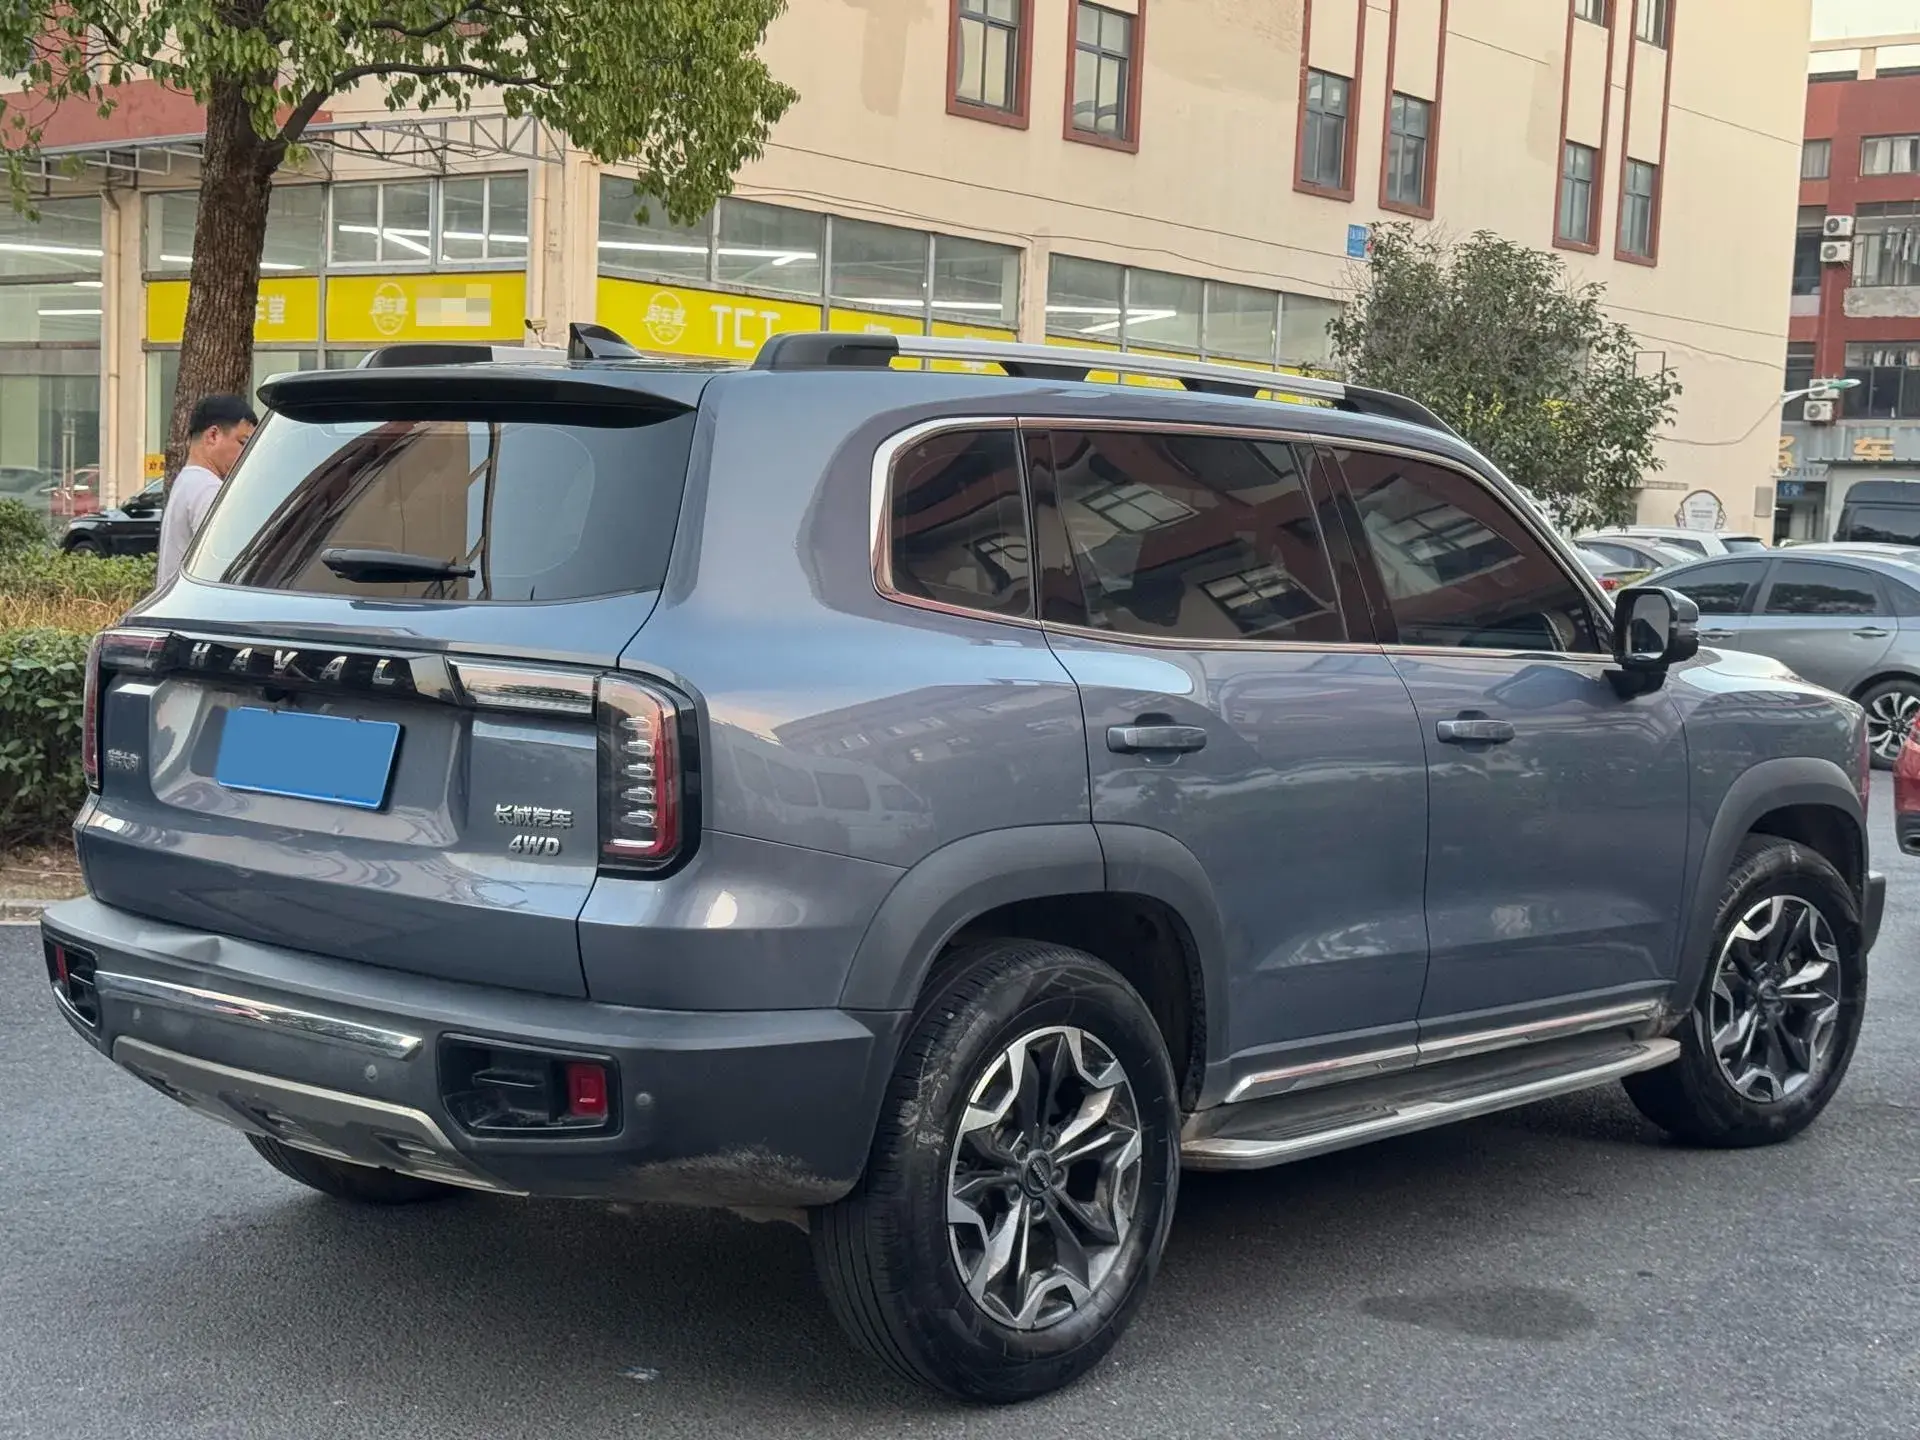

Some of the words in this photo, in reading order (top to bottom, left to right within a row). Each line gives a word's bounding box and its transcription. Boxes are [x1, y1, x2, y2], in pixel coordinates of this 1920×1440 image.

[710, 304, 781, 349] TCT
[189, 642, 396, 685] HAVAL
[494, 803, 573, 828] 长城汽车
[508, 834, 561, 857] 4WD
